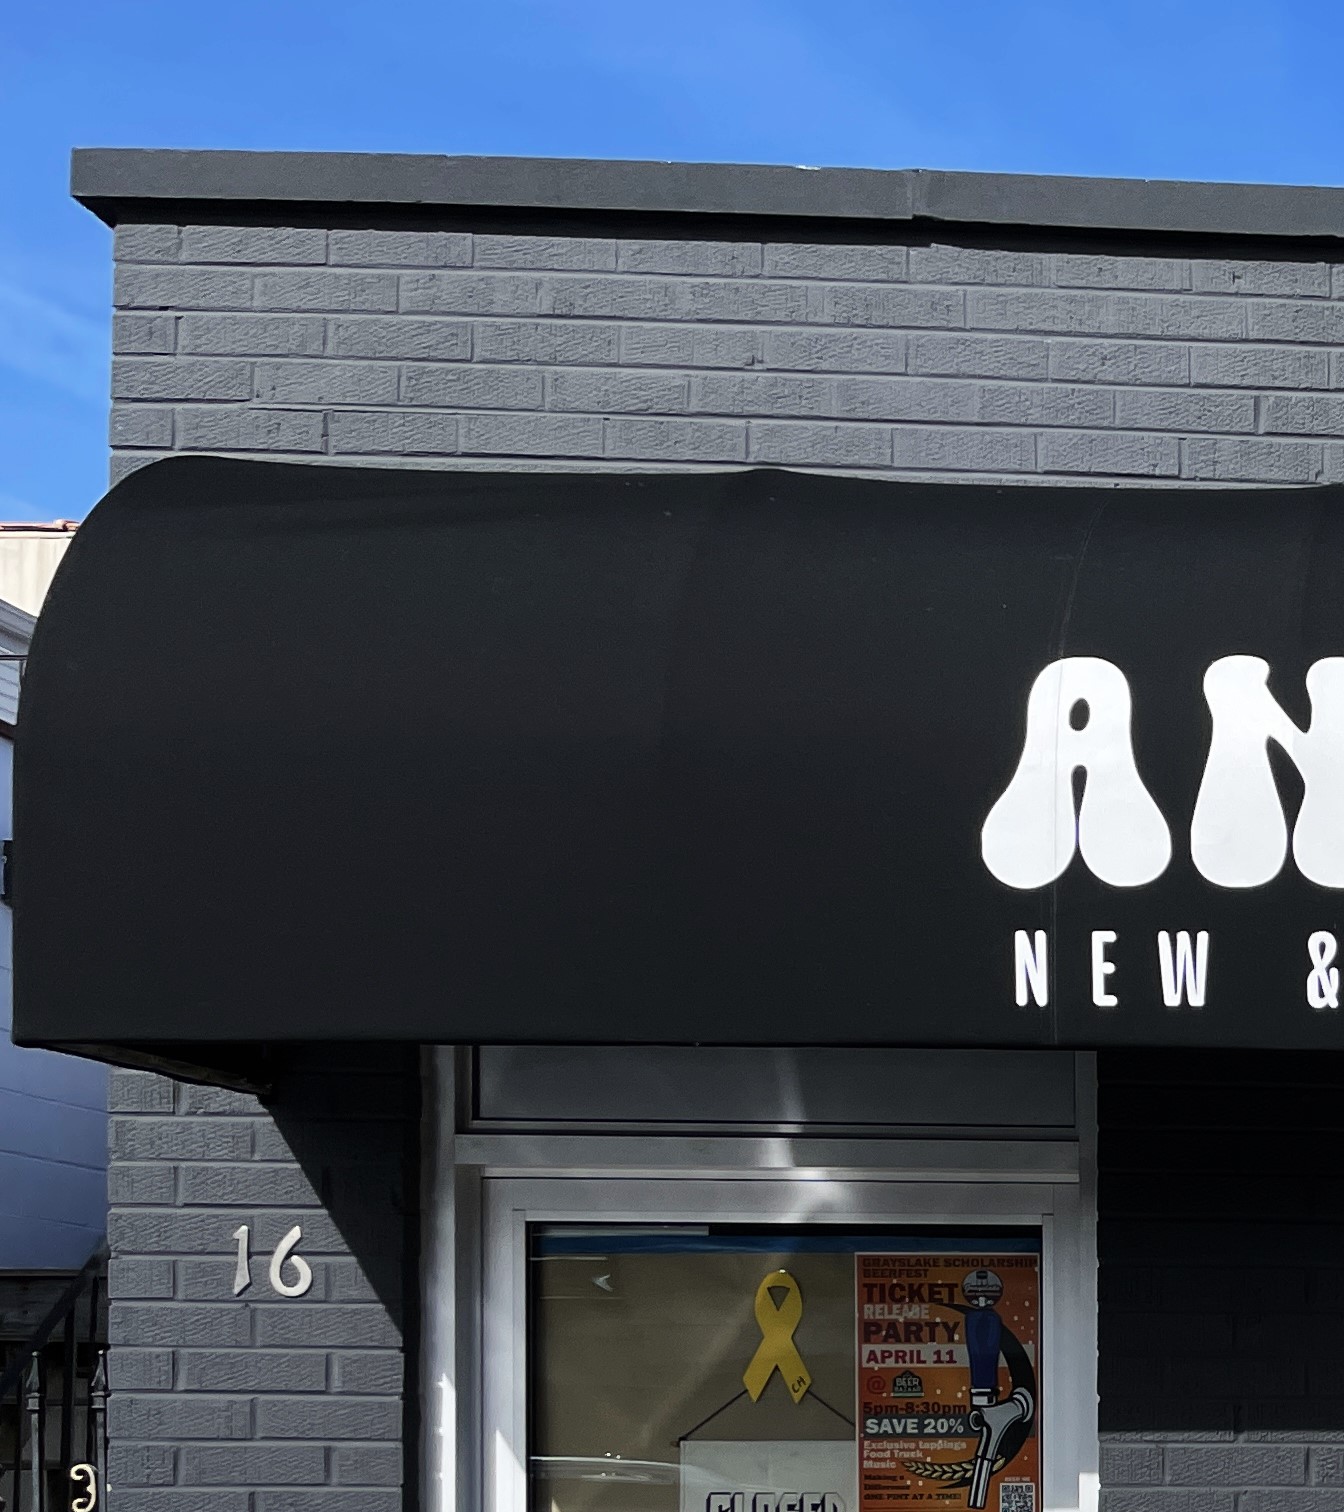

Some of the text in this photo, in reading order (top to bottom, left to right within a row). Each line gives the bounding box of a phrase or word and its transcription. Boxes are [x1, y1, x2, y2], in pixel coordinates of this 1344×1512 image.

[1015, 930, 1209, 1008] NEW
[1307, 931, 1341, 1008] &
[233, 1225, 312, 1297] 16
[862, 1258, 940, 1268] GRAYSLAKE
[862, 1269, 928, 1278] BEERFEST
[862, 1283, 958, 1304] TICKET
[863, 1322, 960, 1342] PARTY
[866, 1350, 957, 1364] APRIL 11
[866, 1376, 886, 1394] @
[864, 1402, 967, 1416] 5pm-8:30pm
[866, 1418, 964, 1434] SAVE 20%
[864, 1440, 916, 1450] Exclusive
[864, 1450, 923, 1458] Food Truck
[864, 1460, 896, 1469] Music
